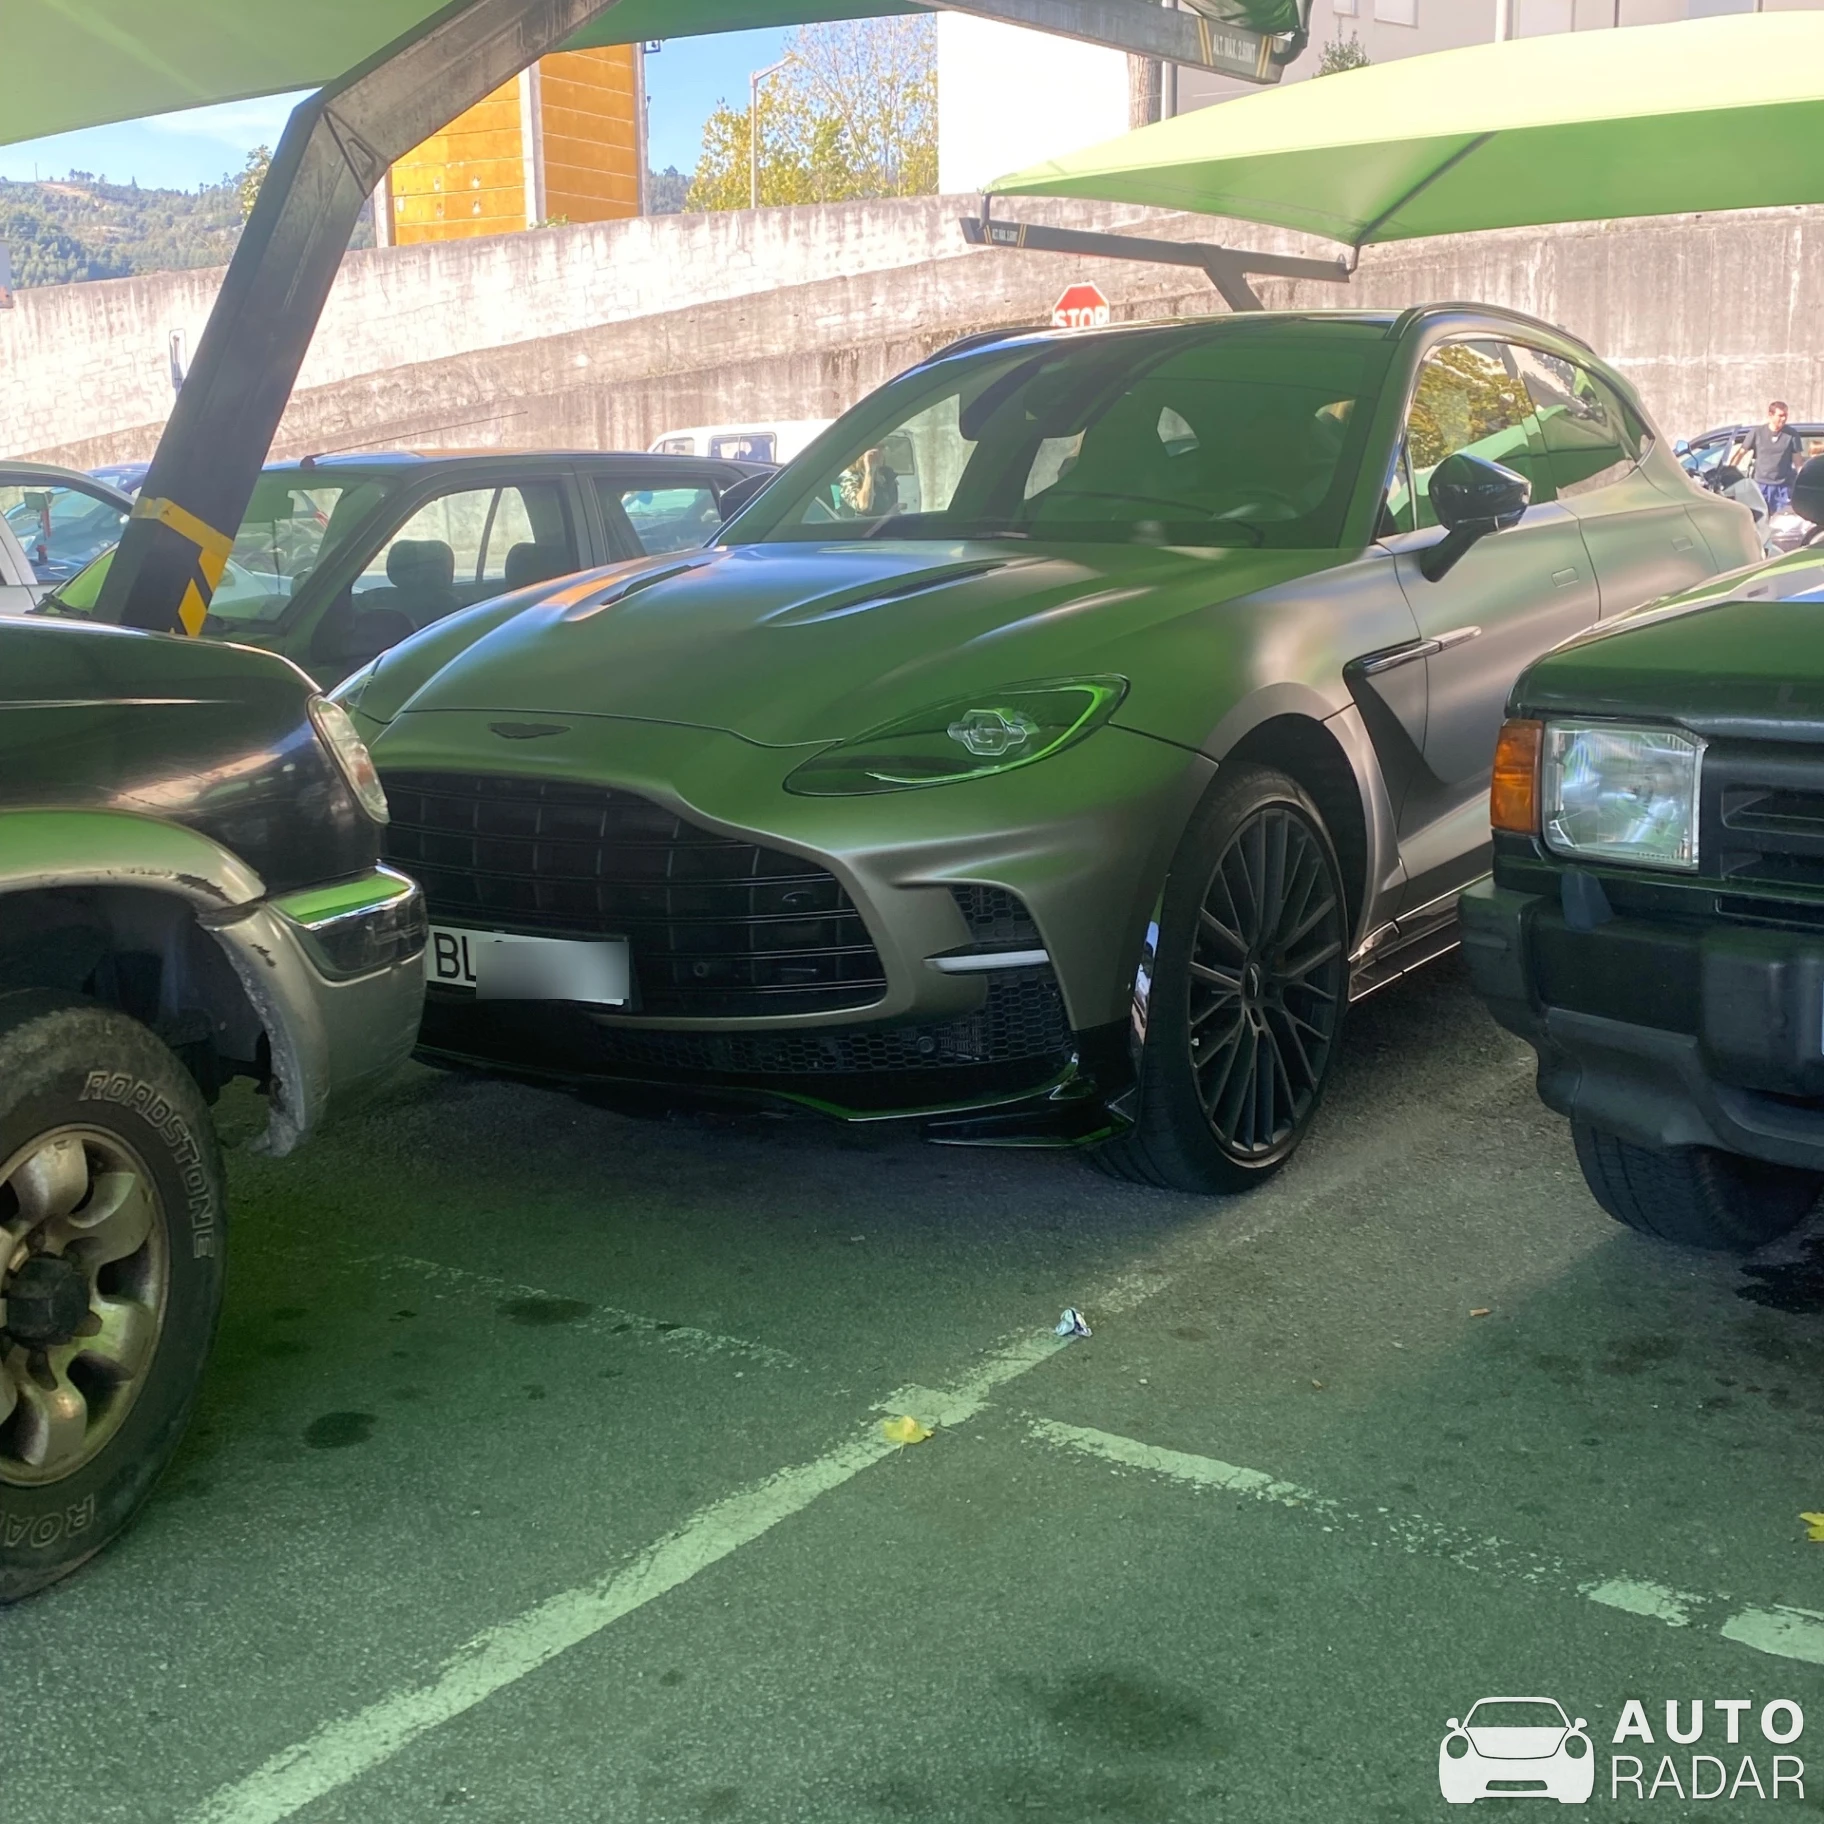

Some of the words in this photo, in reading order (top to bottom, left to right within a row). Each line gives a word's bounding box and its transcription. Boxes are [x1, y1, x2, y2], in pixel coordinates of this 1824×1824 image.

[1055, 306, 1107, 328] STOP
[79, 1070, 215, 1259] ROADSTONE
[0, 1492, 95, 1548] ROA
